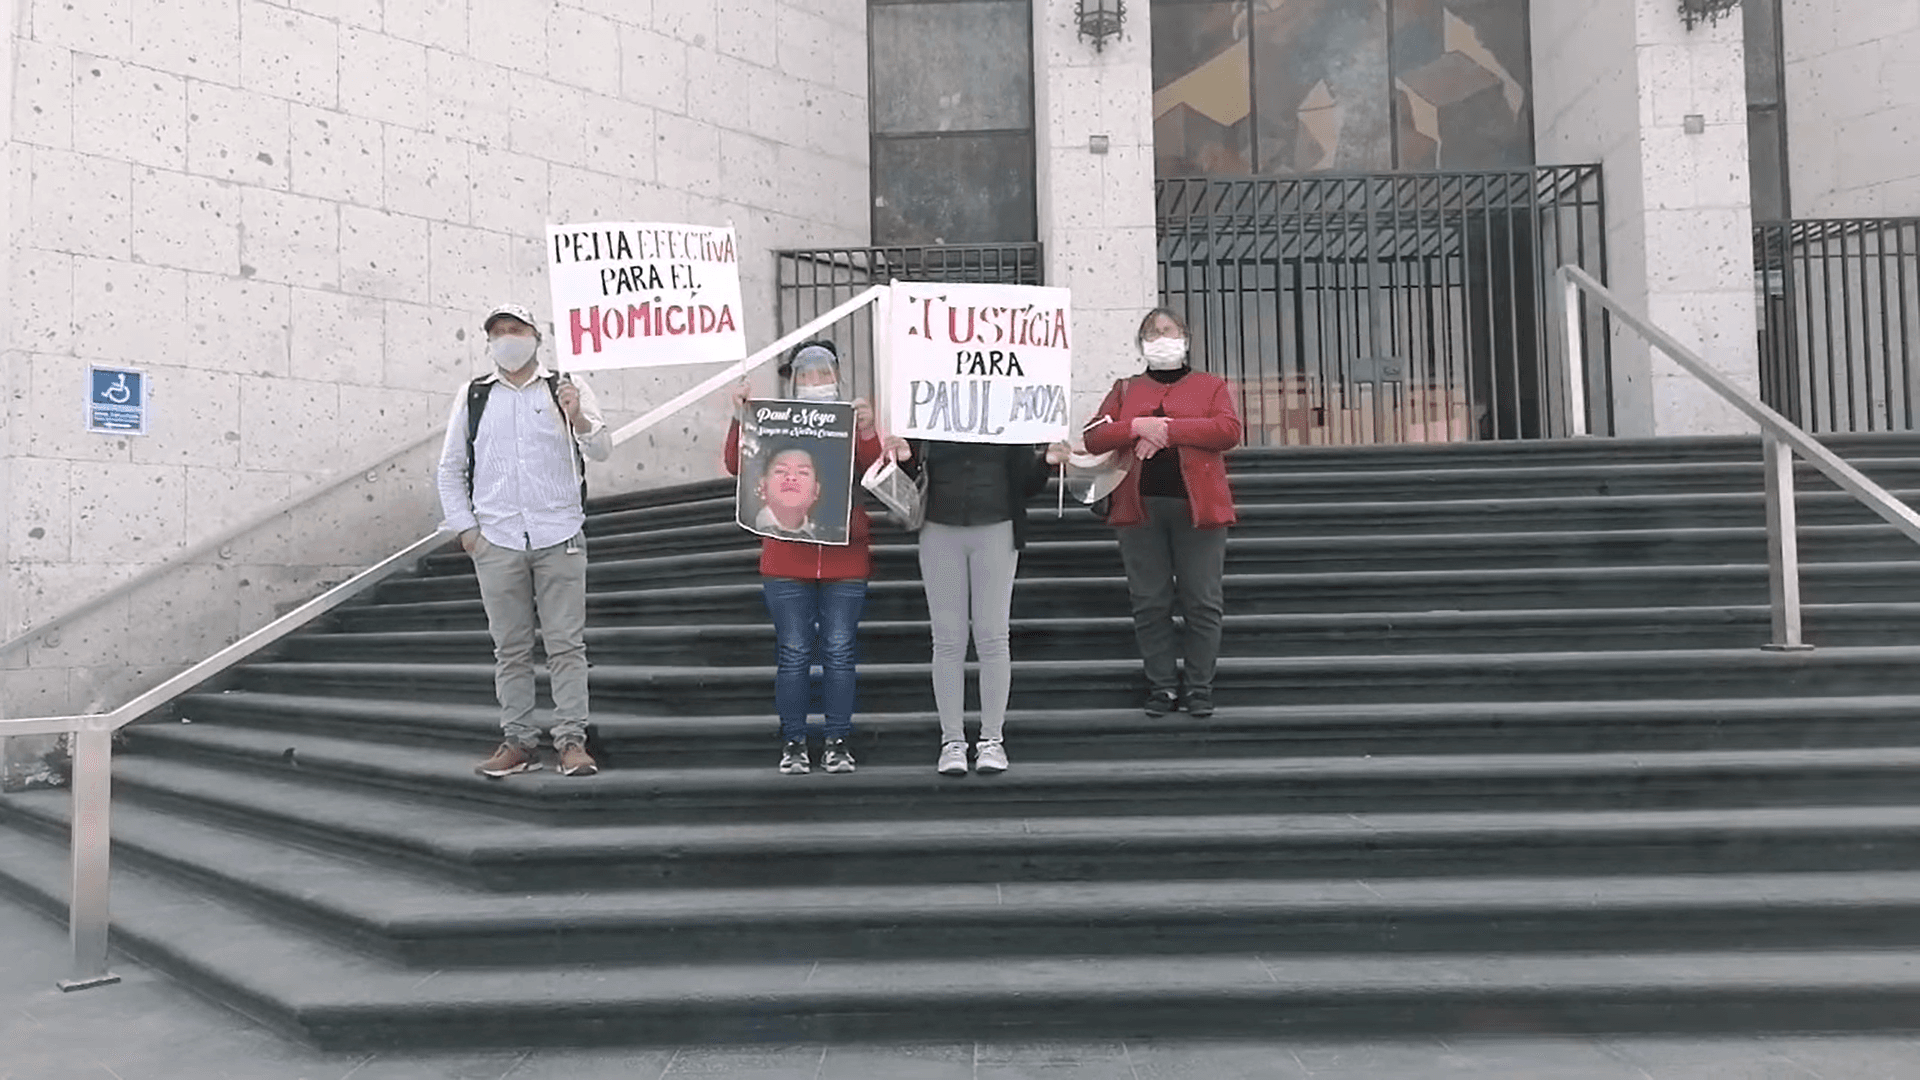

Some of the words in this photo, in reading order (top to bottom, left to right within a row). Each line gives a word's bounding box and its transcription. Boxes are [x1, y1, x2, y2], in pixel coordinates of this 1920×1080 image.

[600, 264, 664, 296] PARA
[671, 264, 702, 290] EL
[955, 350, 1025, 377] PARA
[756, 407, 792, 424] Paul
[792, 408, 837, 428] Moya
[907, 380, 1005, 435] PAUL
[1009, 384, 1068, 427] MOYA
